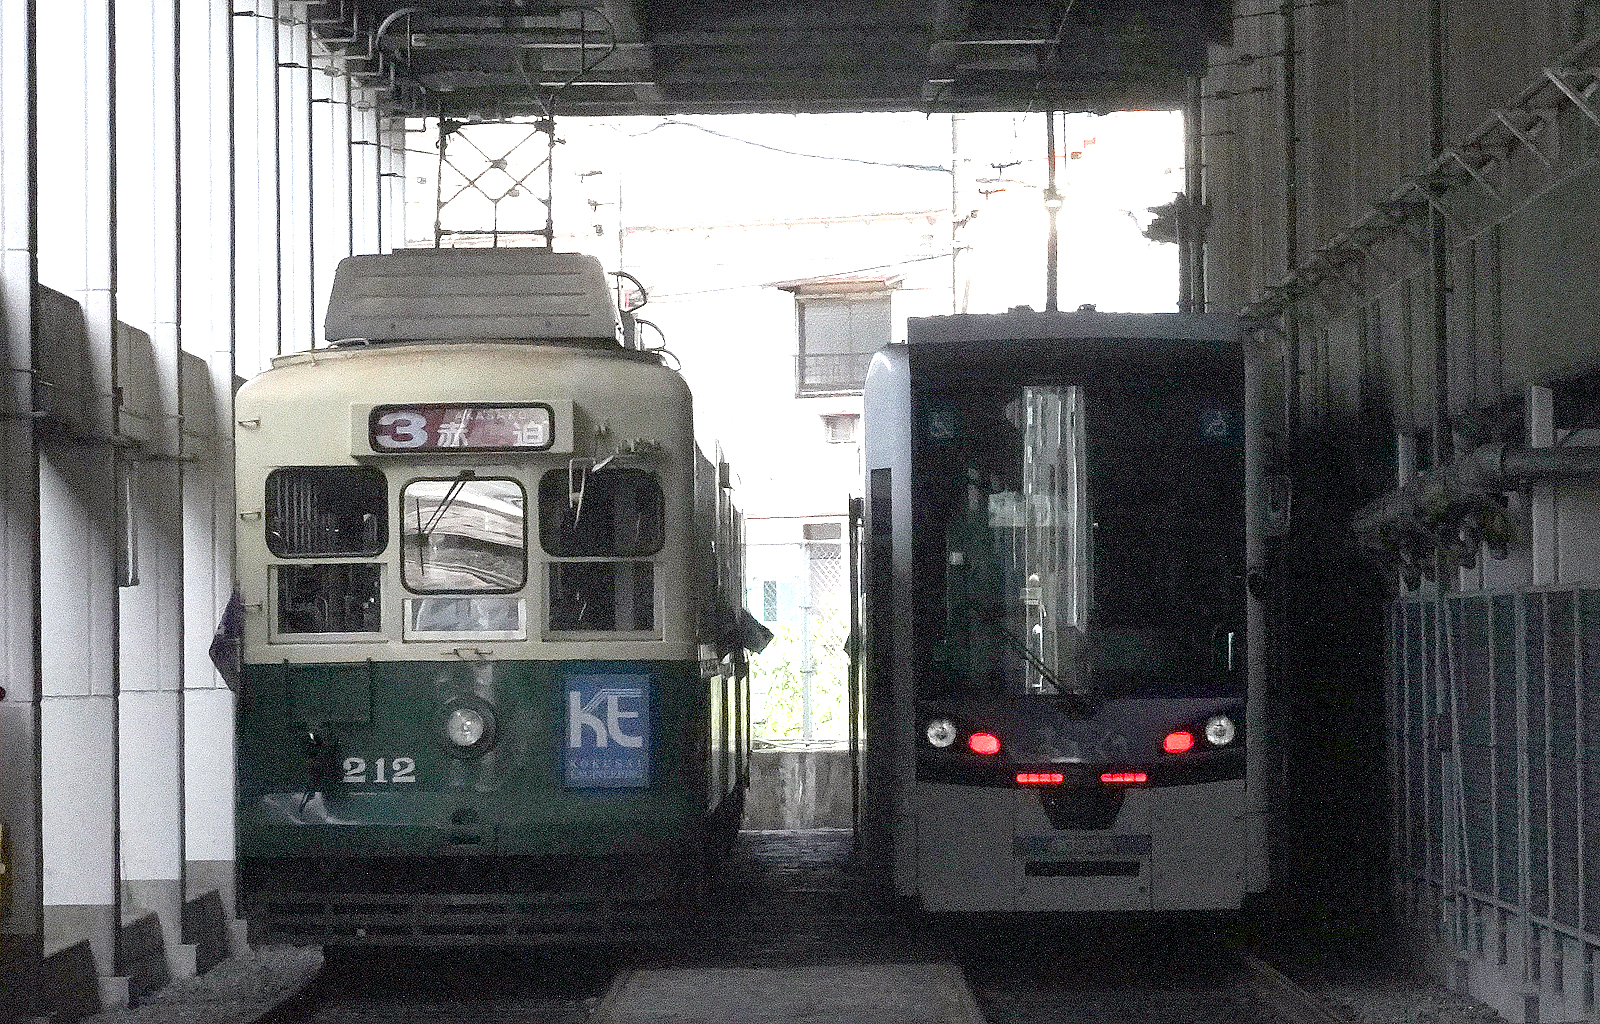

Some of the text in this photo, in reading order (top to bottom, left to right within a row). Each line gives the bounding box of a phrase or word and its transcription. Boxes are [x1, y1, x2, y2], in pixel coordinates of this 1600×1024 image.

[376, 411, 429, 449] 3
[569, 687, 644, 748] KE
[342, 757, 417, 783] 212
